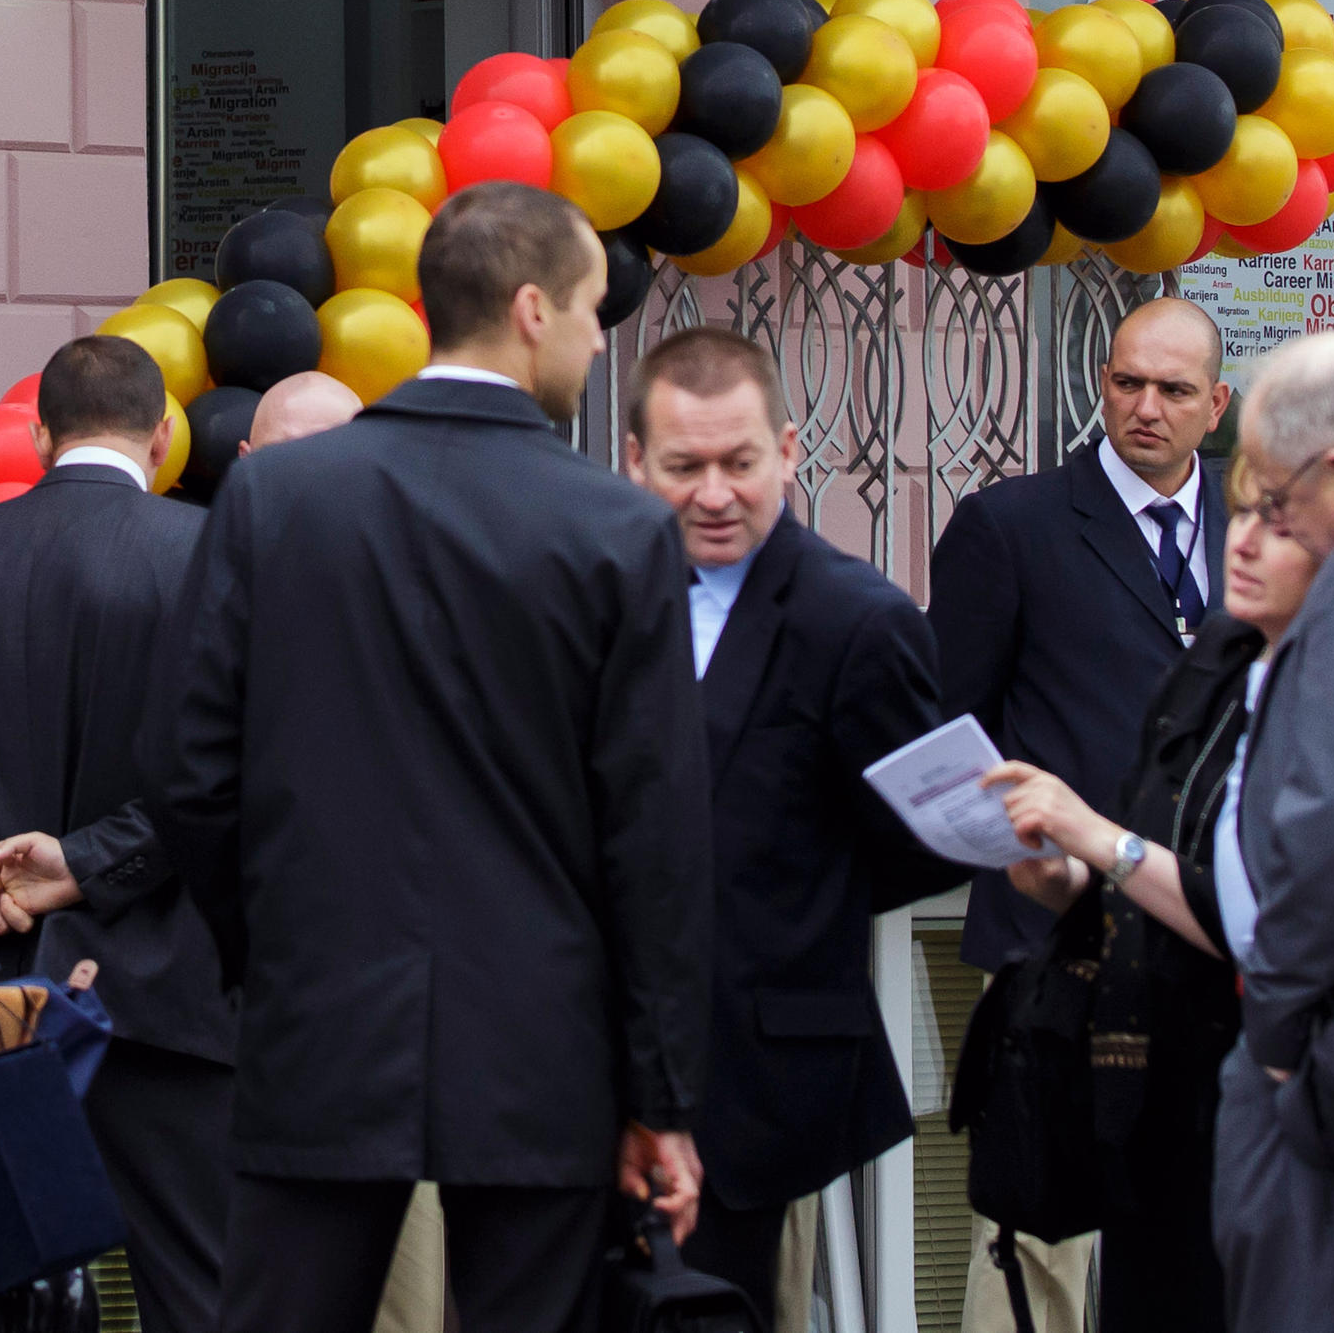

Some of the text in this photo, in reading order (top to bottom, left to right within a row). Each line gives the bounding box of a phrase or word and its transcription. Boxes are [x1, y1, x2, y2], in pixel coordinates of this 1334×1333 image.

[191, 62, 257, 78] Migracija
[256, 84, 290, 95] Arsim
[209, 96, 277, 112] Migration
[187, 127, 226, 138] Arsim
[212, 150, 264, 163] Migration
[255, 159, 301, 173] Migrim
[1180, 264, 1227, 277] usbildung
[1264, 271, 1312, 289] Career
[1184, 289, 1219, 303] Karijera
[1233, 287, 1305, 307] Ausbildung
[1218, 307, 1249, 317] Migration
[1258, 307, 1304, 326] Karijera
[1225, 327, 1261, 341] Training
[1263, 326, 1301, 342] Migrim
